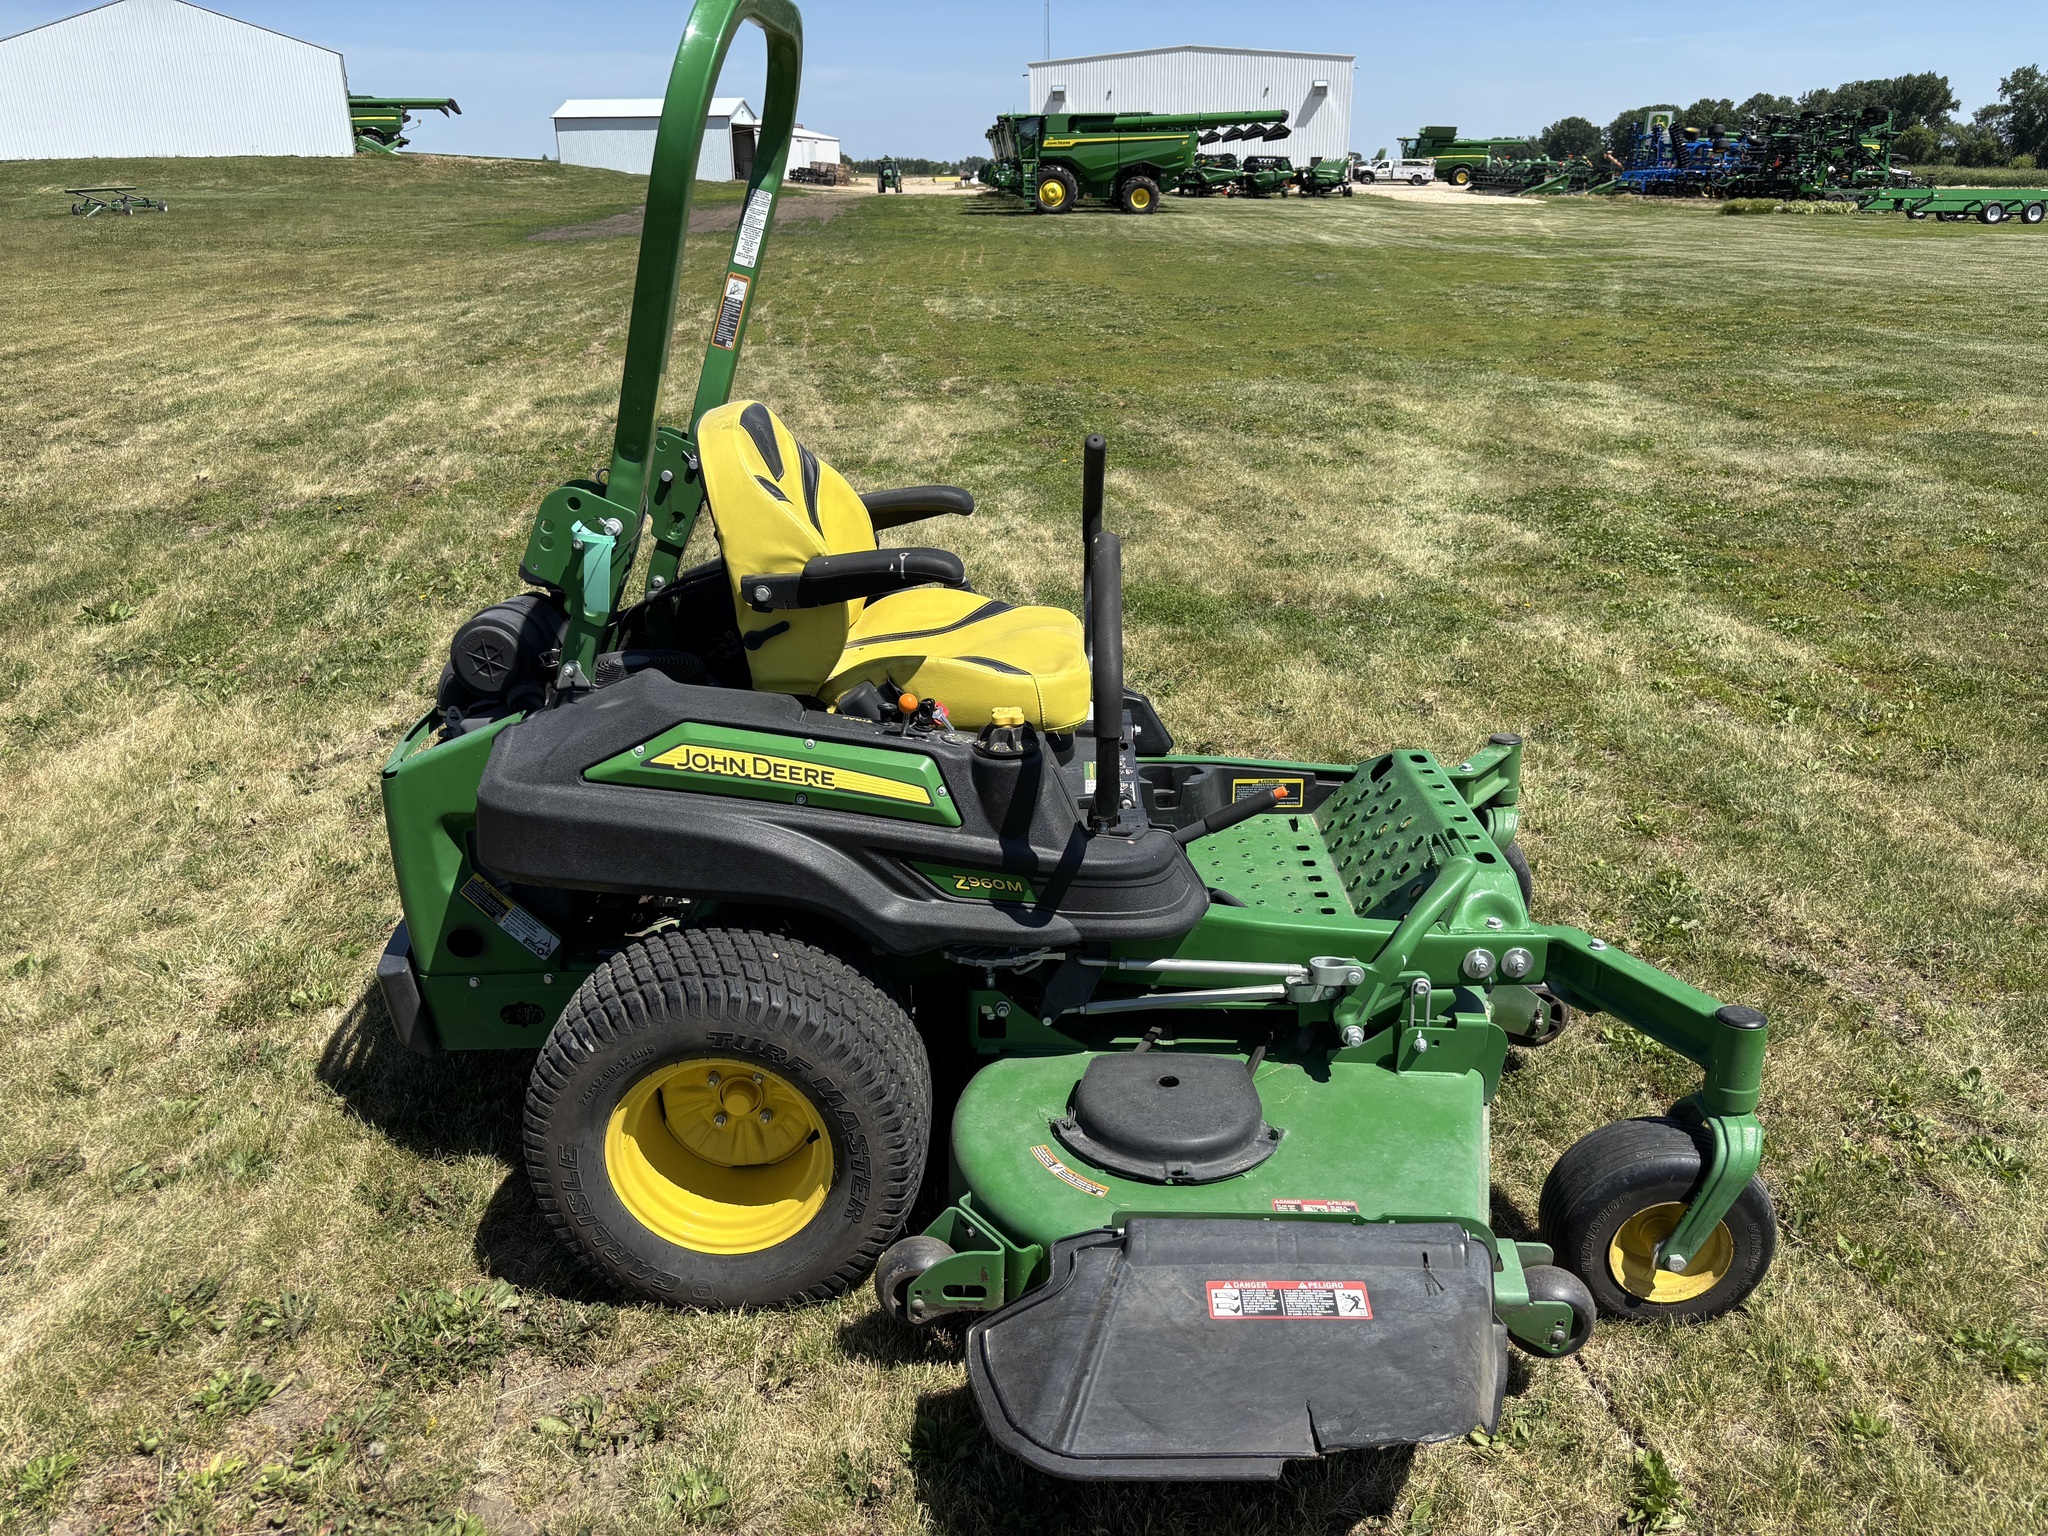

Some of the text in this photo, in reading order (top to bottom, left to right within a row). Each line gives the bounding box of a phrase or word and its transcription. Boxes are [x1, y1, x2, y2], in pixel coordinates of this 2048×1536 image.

[677, 748, 835, 787] JOHN DEERE
[952, 874, 1023, 893] Z960M
[707, 1031, 873, 1225] TURF MASTER
[557, 1143, 683, 1293] CARLISLE
[1233, 1281, 1268, 1289] DANGER
[1307, 1281, 1344, 1290] PELIGRO
